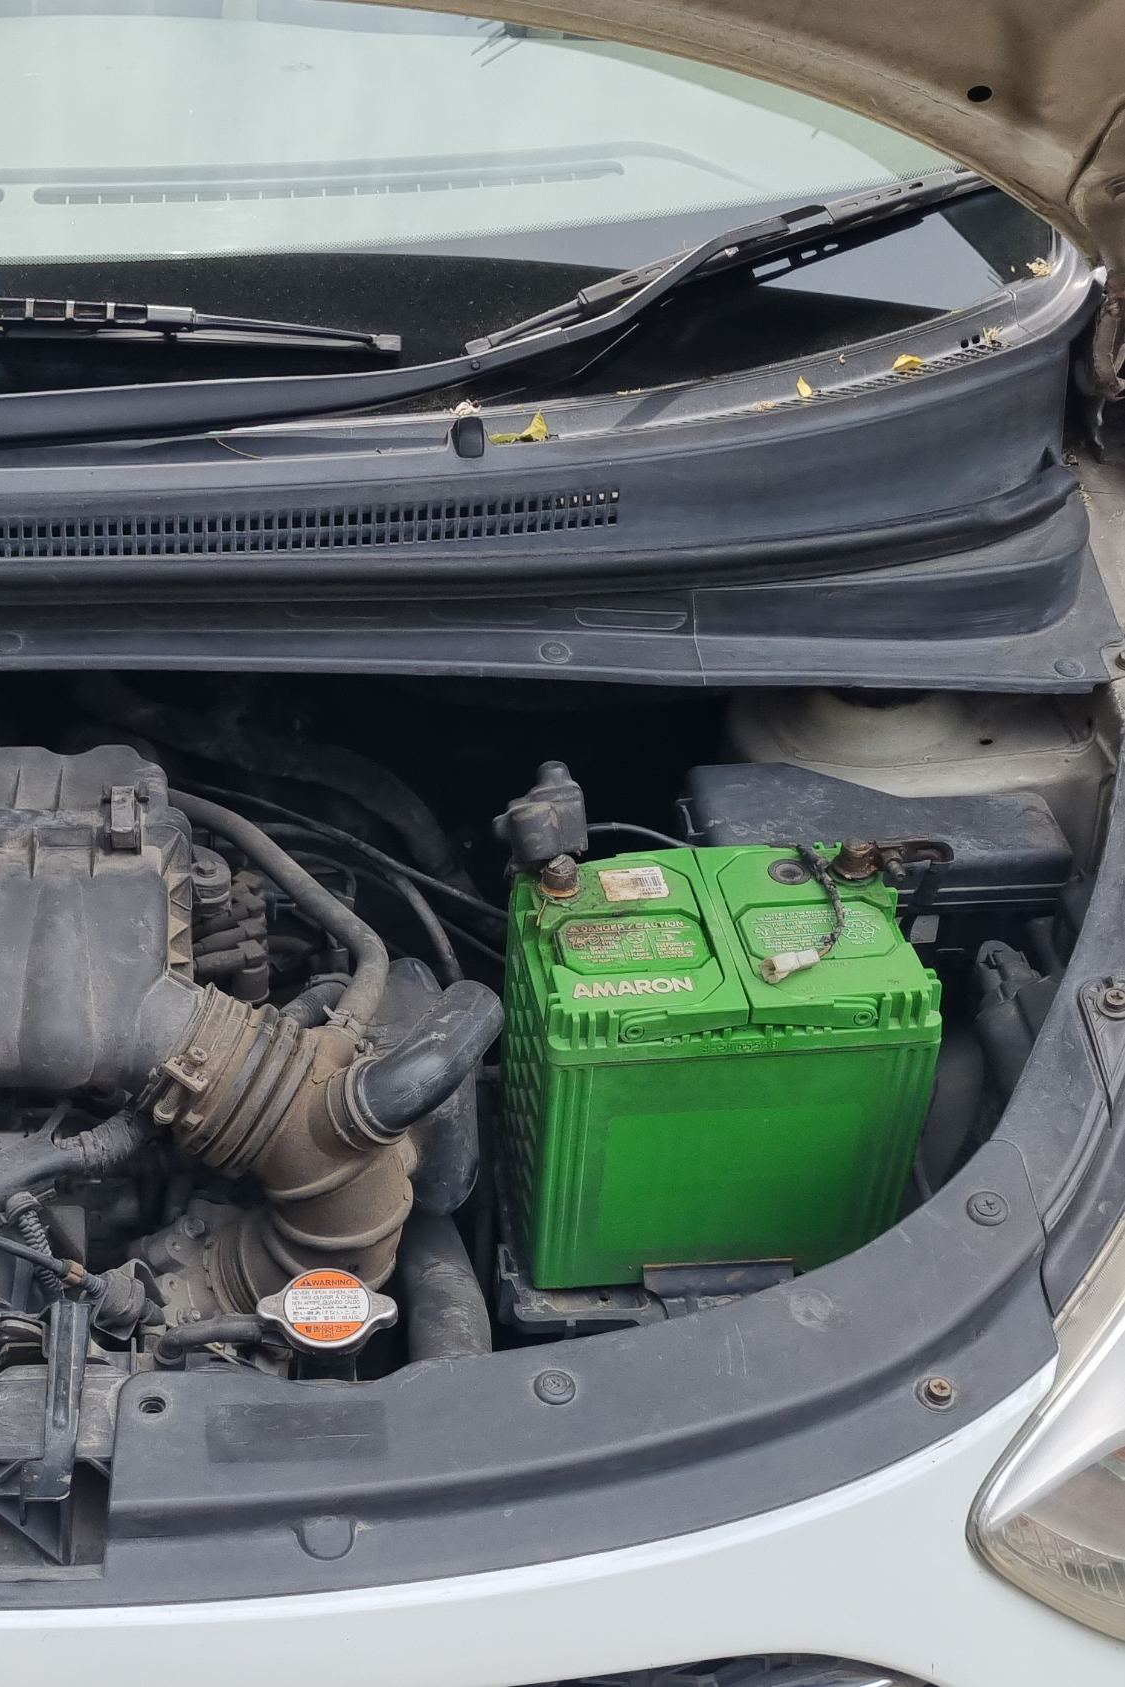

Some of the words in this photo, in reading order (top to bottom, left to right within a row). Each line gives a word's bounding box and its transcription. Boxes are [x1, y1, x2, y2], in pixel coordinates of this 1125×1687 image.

[582, 924, 625, 932] DANGER
[636, 920, 684, 929] CAUTION
[572, 976, 694, 998] AMARON
